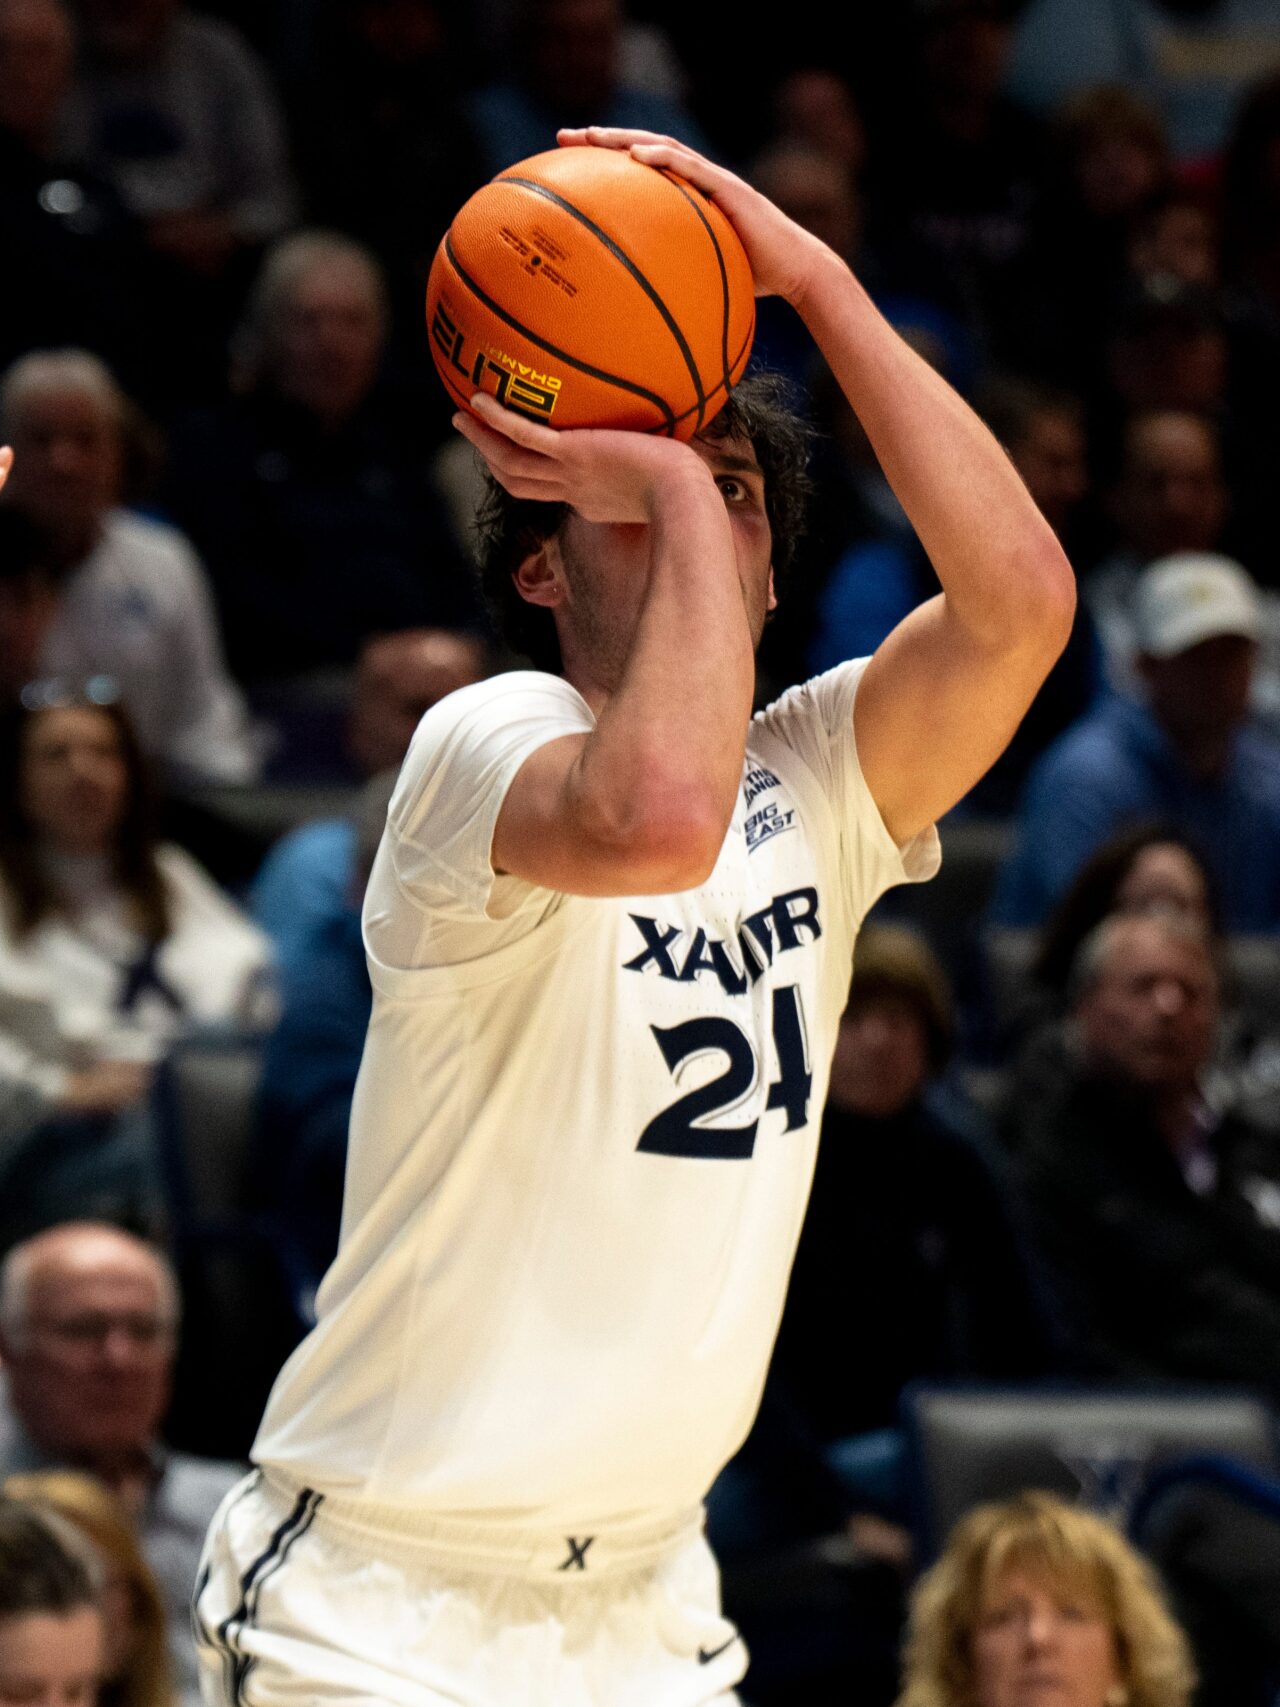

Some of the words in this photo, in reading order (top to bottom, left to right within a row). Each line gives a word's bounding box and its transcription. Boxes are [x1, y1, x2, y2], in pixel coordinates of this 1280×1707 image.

[432, 300, 558, 427] ELITE
[485, 344, 562, 391] CHAMP
[745, 802, 778, 832] BIG
[746, 809, 795, 847] EAST
[635, 983, 812, 1160] 24
[558, 1535, 595, 1571] X
